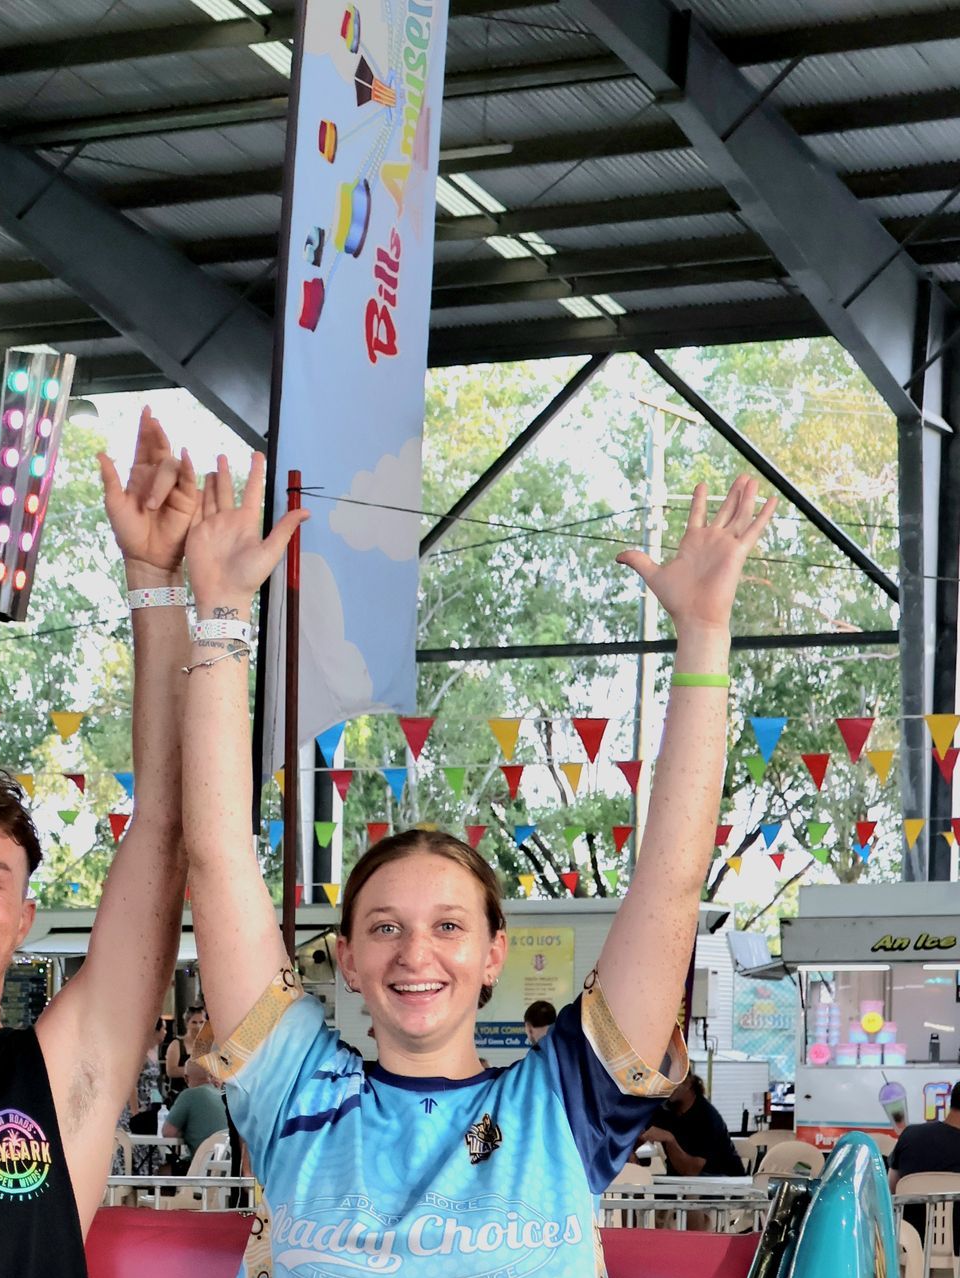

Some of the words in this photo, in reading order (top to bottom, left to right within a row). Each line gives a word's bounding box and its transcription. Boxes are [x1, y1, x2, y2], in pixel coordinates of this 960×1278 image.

[364, 226, 402, 365] Bills
[871, 934, 909, 951] An
[913, 933, 958, 951] Ice
[8, 1113, 34, 1132] ROADS
[407, 1210, 583, 1257] Choices
